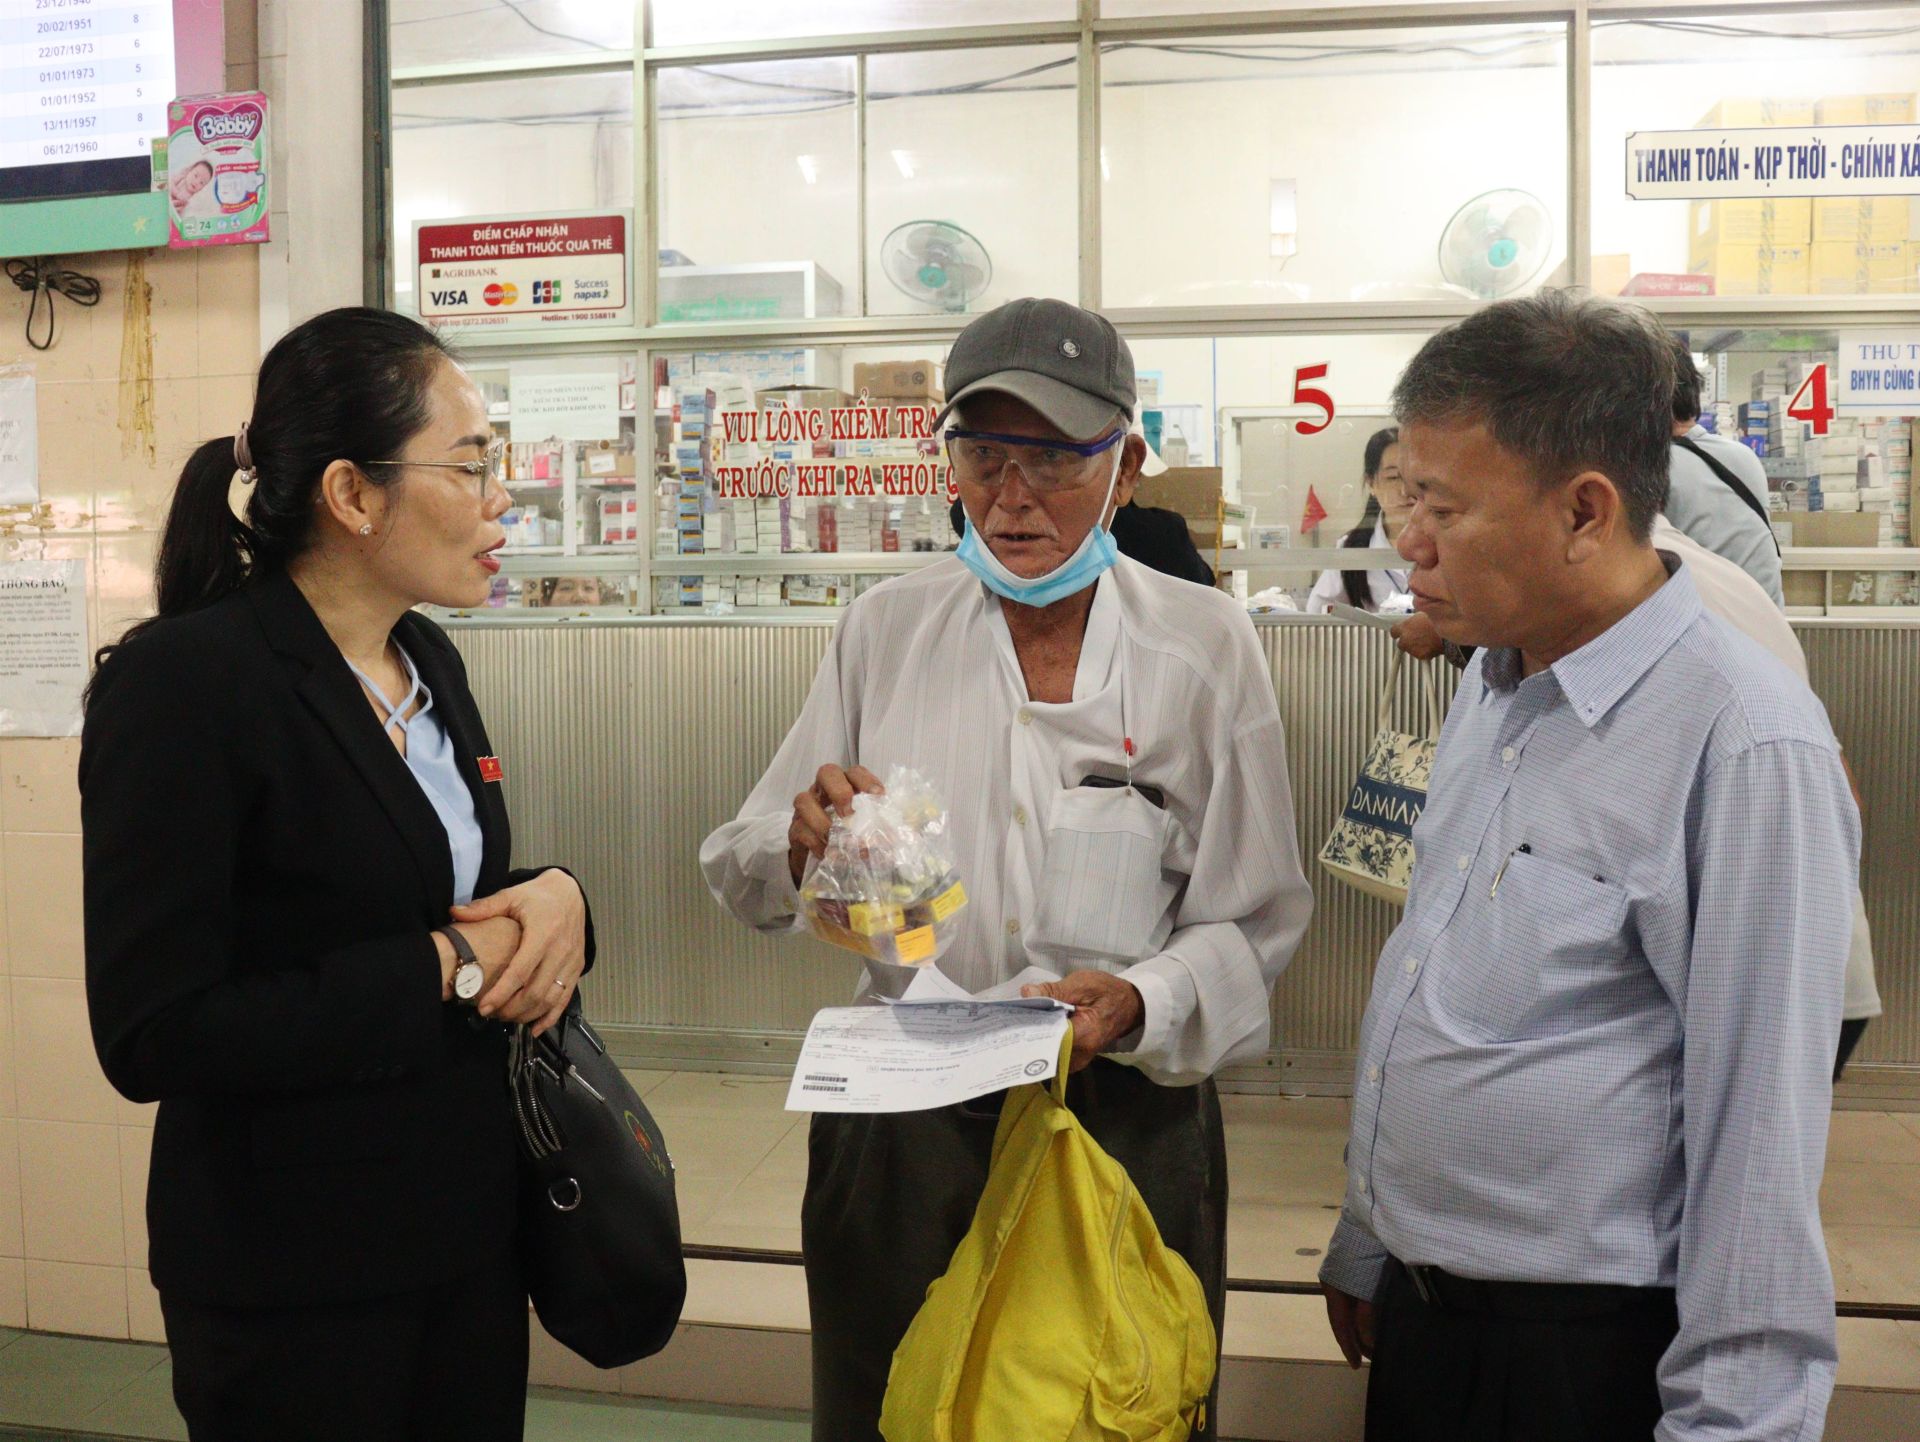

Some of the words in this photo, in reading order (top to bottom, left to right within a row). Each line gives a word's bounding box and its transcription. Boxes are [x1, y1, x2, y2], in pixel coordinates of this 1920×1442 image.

[37, 18, 92, 33] 20/02/1951
[133, 14, 139, 23] 8
[38, 43, 94, 58] 22/07/1973
[134, 39, 140, 48] 6
[40, 68, 95, 82] 01/01/1973
[135, 63, 141, 73] 5
[41, 92, 96, 106] 01/01/1952
[136, 88, 142, 97] 5
[44, 116, 97, 131] 13/11/1957
[137, 113, 143, 122] 8
[199, 112, 258, 139] Bobby
[43, 141, 98, 156] 06/12/1960
[138, 137, 144, 147] 6
[1635, 148, 1690, 182] THANH
[1696, 139, 1739, 181] TOÁN
[1755, 147, 1782, 188] KỊP
[1787, 137, 1826, 179] THỜI
[1842, 137, 1896, 178] CHÍNH
[200, 221, 211, 230] 74
[430, 246, 467, 258] THANH
[469, 243, 499, 256] TOÁN
[566, 238, 590, 251] QUA
[592, 234, 613, 250] THẺ
[443, 267, 498, 278] AGRIBANK
[574, 279, 609, 289] Success
[429, 290, 468, 306] VISA
[573, 290, 602, 301] napas
[541, 314, 570, 322] Hotline:
[1884, 364, 1914, 391] CÙNG
[1293, 363, 1335, 435] 5
[1787, 363, 1834, 435] 4
[721, 411, 758, 443] VUI
[765, 401, 823, 442] LÒNG
[830, 388, 889, 440] KIỂM
[716, 457, 789, 498] TRƯỚC
[797, 464, 837, 496] KHI
[844, 464, 876, 496] RA
[882, 450, 938, 496] KHỎI
